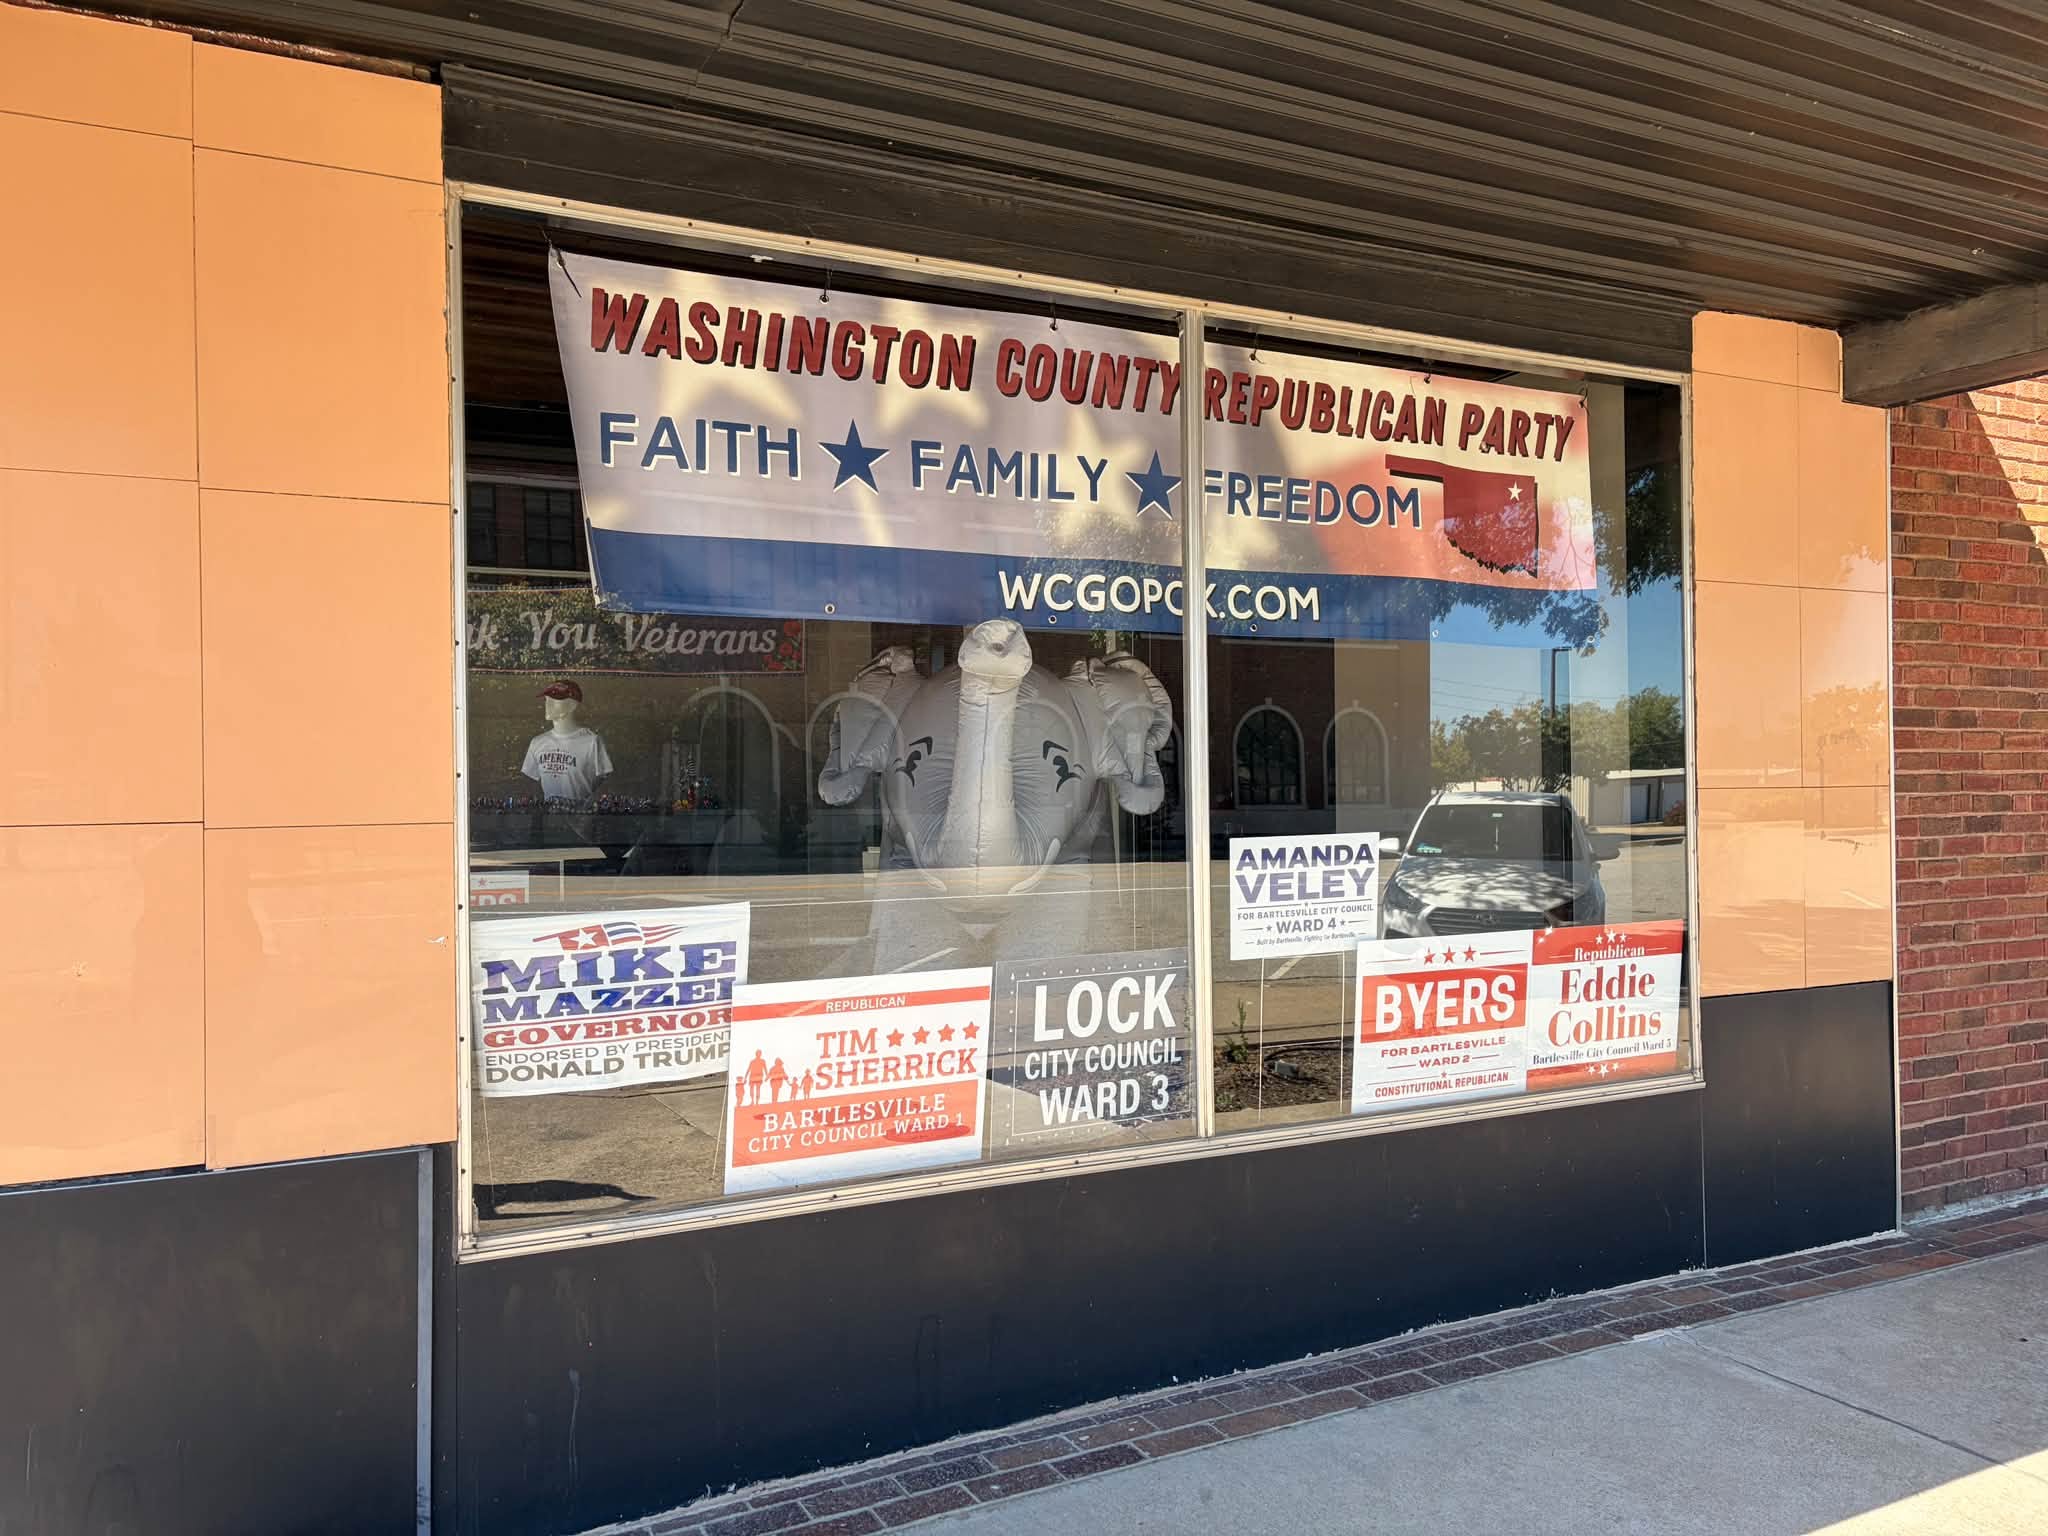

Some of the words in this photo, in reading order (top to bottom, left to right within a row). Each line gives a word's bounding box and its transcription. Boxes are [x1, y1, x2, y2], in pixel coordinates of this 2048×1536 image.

[590, 287, 977, 392] WASHINGTON
[996, 337, 1181, 416] COUNTY
[1204, 366, 1447, 449] REPUBLICAN
[1459, 403, 1575, 462] PARTY
[600, 411, 801, 481] FAITH
[911, 439, 1109, 503] FAMILY
[1204, 469, 1422, 529] FREEDOM
[518, 610, 601, 651] You
[612, 611, 778, 656] Veterans
[1235, 843, 1376, 872] AMANDA
[1234, 866, 1376, 904] VELEY
[1237, 912, 1255, 921] FOR
[1257, 907, 1319, 919] BARTLESVILLE
[1320, 906, 1339, 916] CITY
[1341, 903, 1375, 914] COUNCIL
[1276, 918, 1324, 934] WARD
[1327, 917, 1337, 930] 4
[481, 941, 737, 996] MIKE
[1574, 944, 1645, 965] Republican
[825, 995, 906, 1013] REPUBLICAN
[1375, 974, 1516, 1034] BYERS
[1560, 963, 1656, 1005] Eddie
[482, 1006, 732, 1048] GOVERNOR
[1033, 973, 1178, 1042] LOCK
[1548, 1004, 1662, 1048] Collins
[486, 1047, 600, 1067] ENDORSED
[606, 1042, 630, 1056] BY
[486, 1056, 625, 1085] DONALD
[633, 1041, 730, 1070] TRUMP
[815, 1027, 879, 1060] TIM
[1024, 1047, 1080, 1081] CITY
[1084, 1036, 1183, 1074] COUNCIL
[1380, 1046, 1408, 1058] FOR
[1410, 1036, 1506, 1056] BARTLESVILLE
[1419, 1055, 1461, 1068] WARD
[1461, 1054, 1471, 1063] 2
[1533, 1051, 1584, 1065] Bartlesville
[1586, 1047, 1603, 1059] City
[1606, 1042, 1640, 1057] Council
[1642, 1039, 1665, 1051] Ward
[815, 1047, 979, 1091] SHERRICK
[1375, 1081, 1453, 1098] CONSTITUTIONAL
[1454, 1071, 1509, 1089] REPUBLICAN
[762, 1092, 946, 1134] BARTLESVILLE
[1039, 1078, 1141, 1126] WARD
[1151, 1073, 1170, 1111] 3
[747, 1134, 795, 1154] CITY
[800, 1122, 887, 1147] COUNCIL
[893, 1114, 950, 1135] WARD
[955, 1111, 964, 1127] 1
